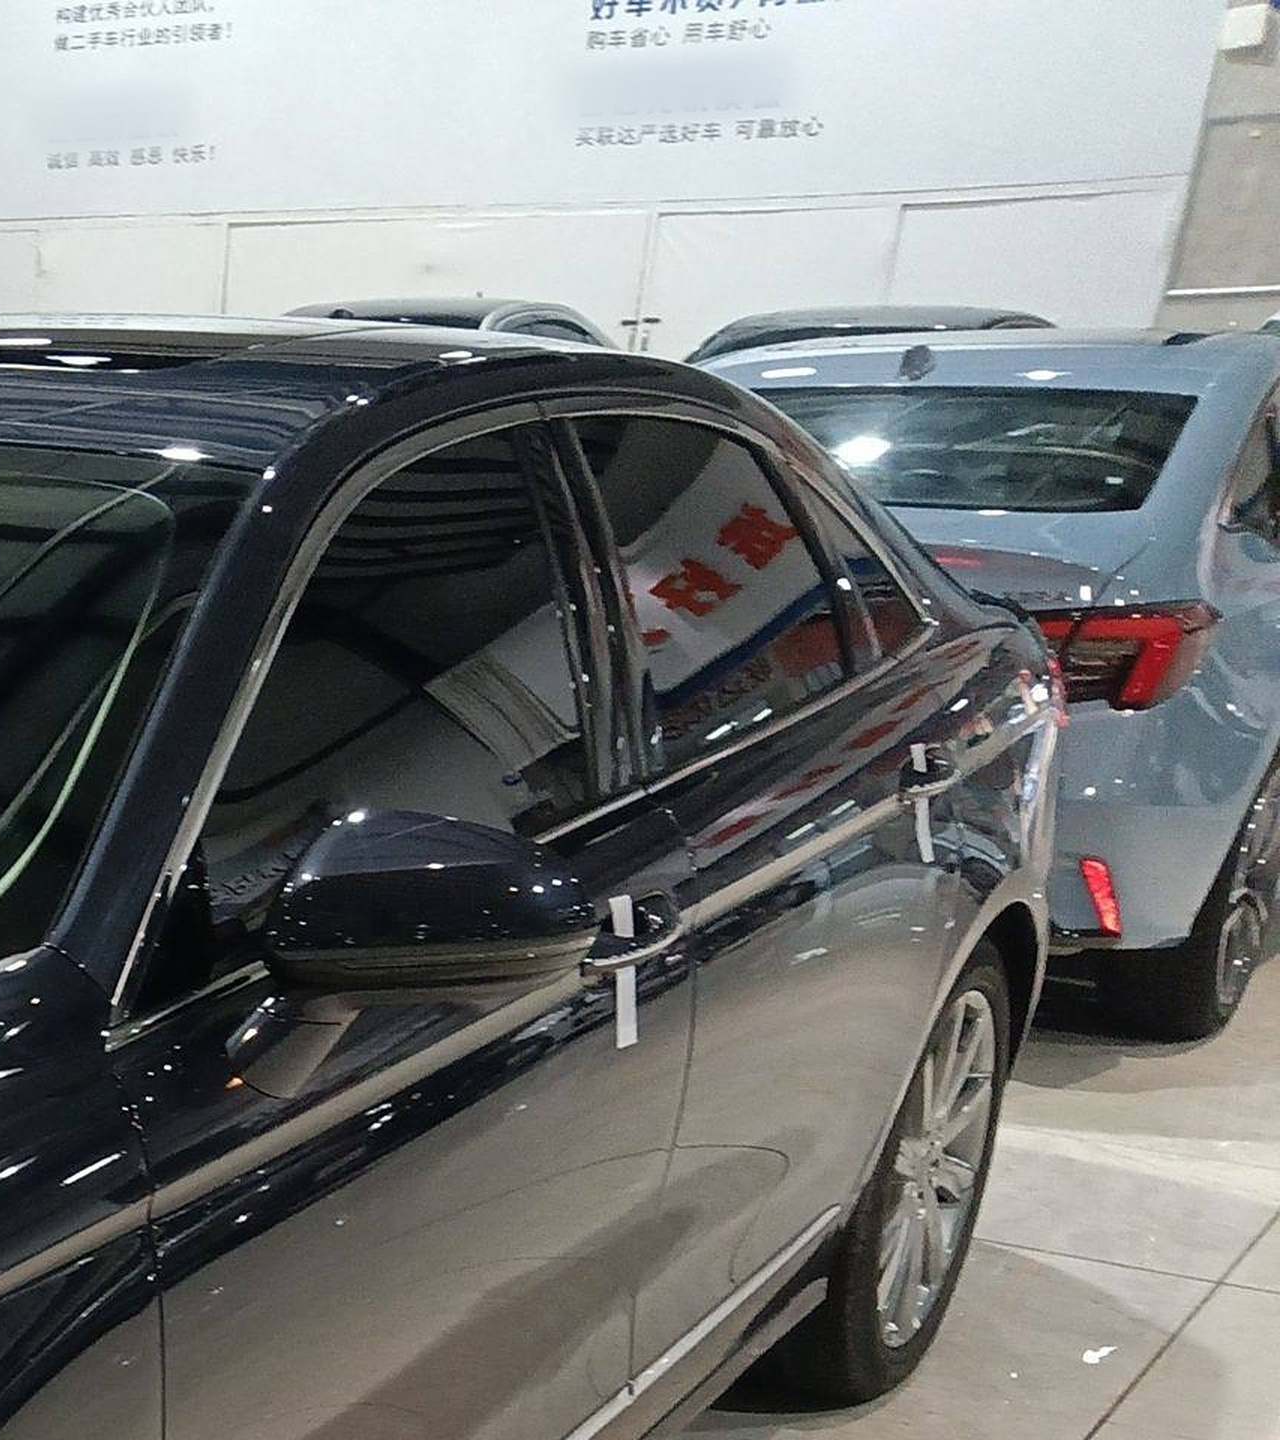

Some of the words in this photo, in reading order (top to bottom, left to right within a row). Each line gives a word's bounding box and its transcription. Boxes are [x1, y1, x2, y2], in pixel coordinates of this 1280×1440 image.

[587, 26, 671, 49] 购车省心
[683, 17, 771, 43] 用车舒心
[735, 115, 824, 141] 可靠放心
